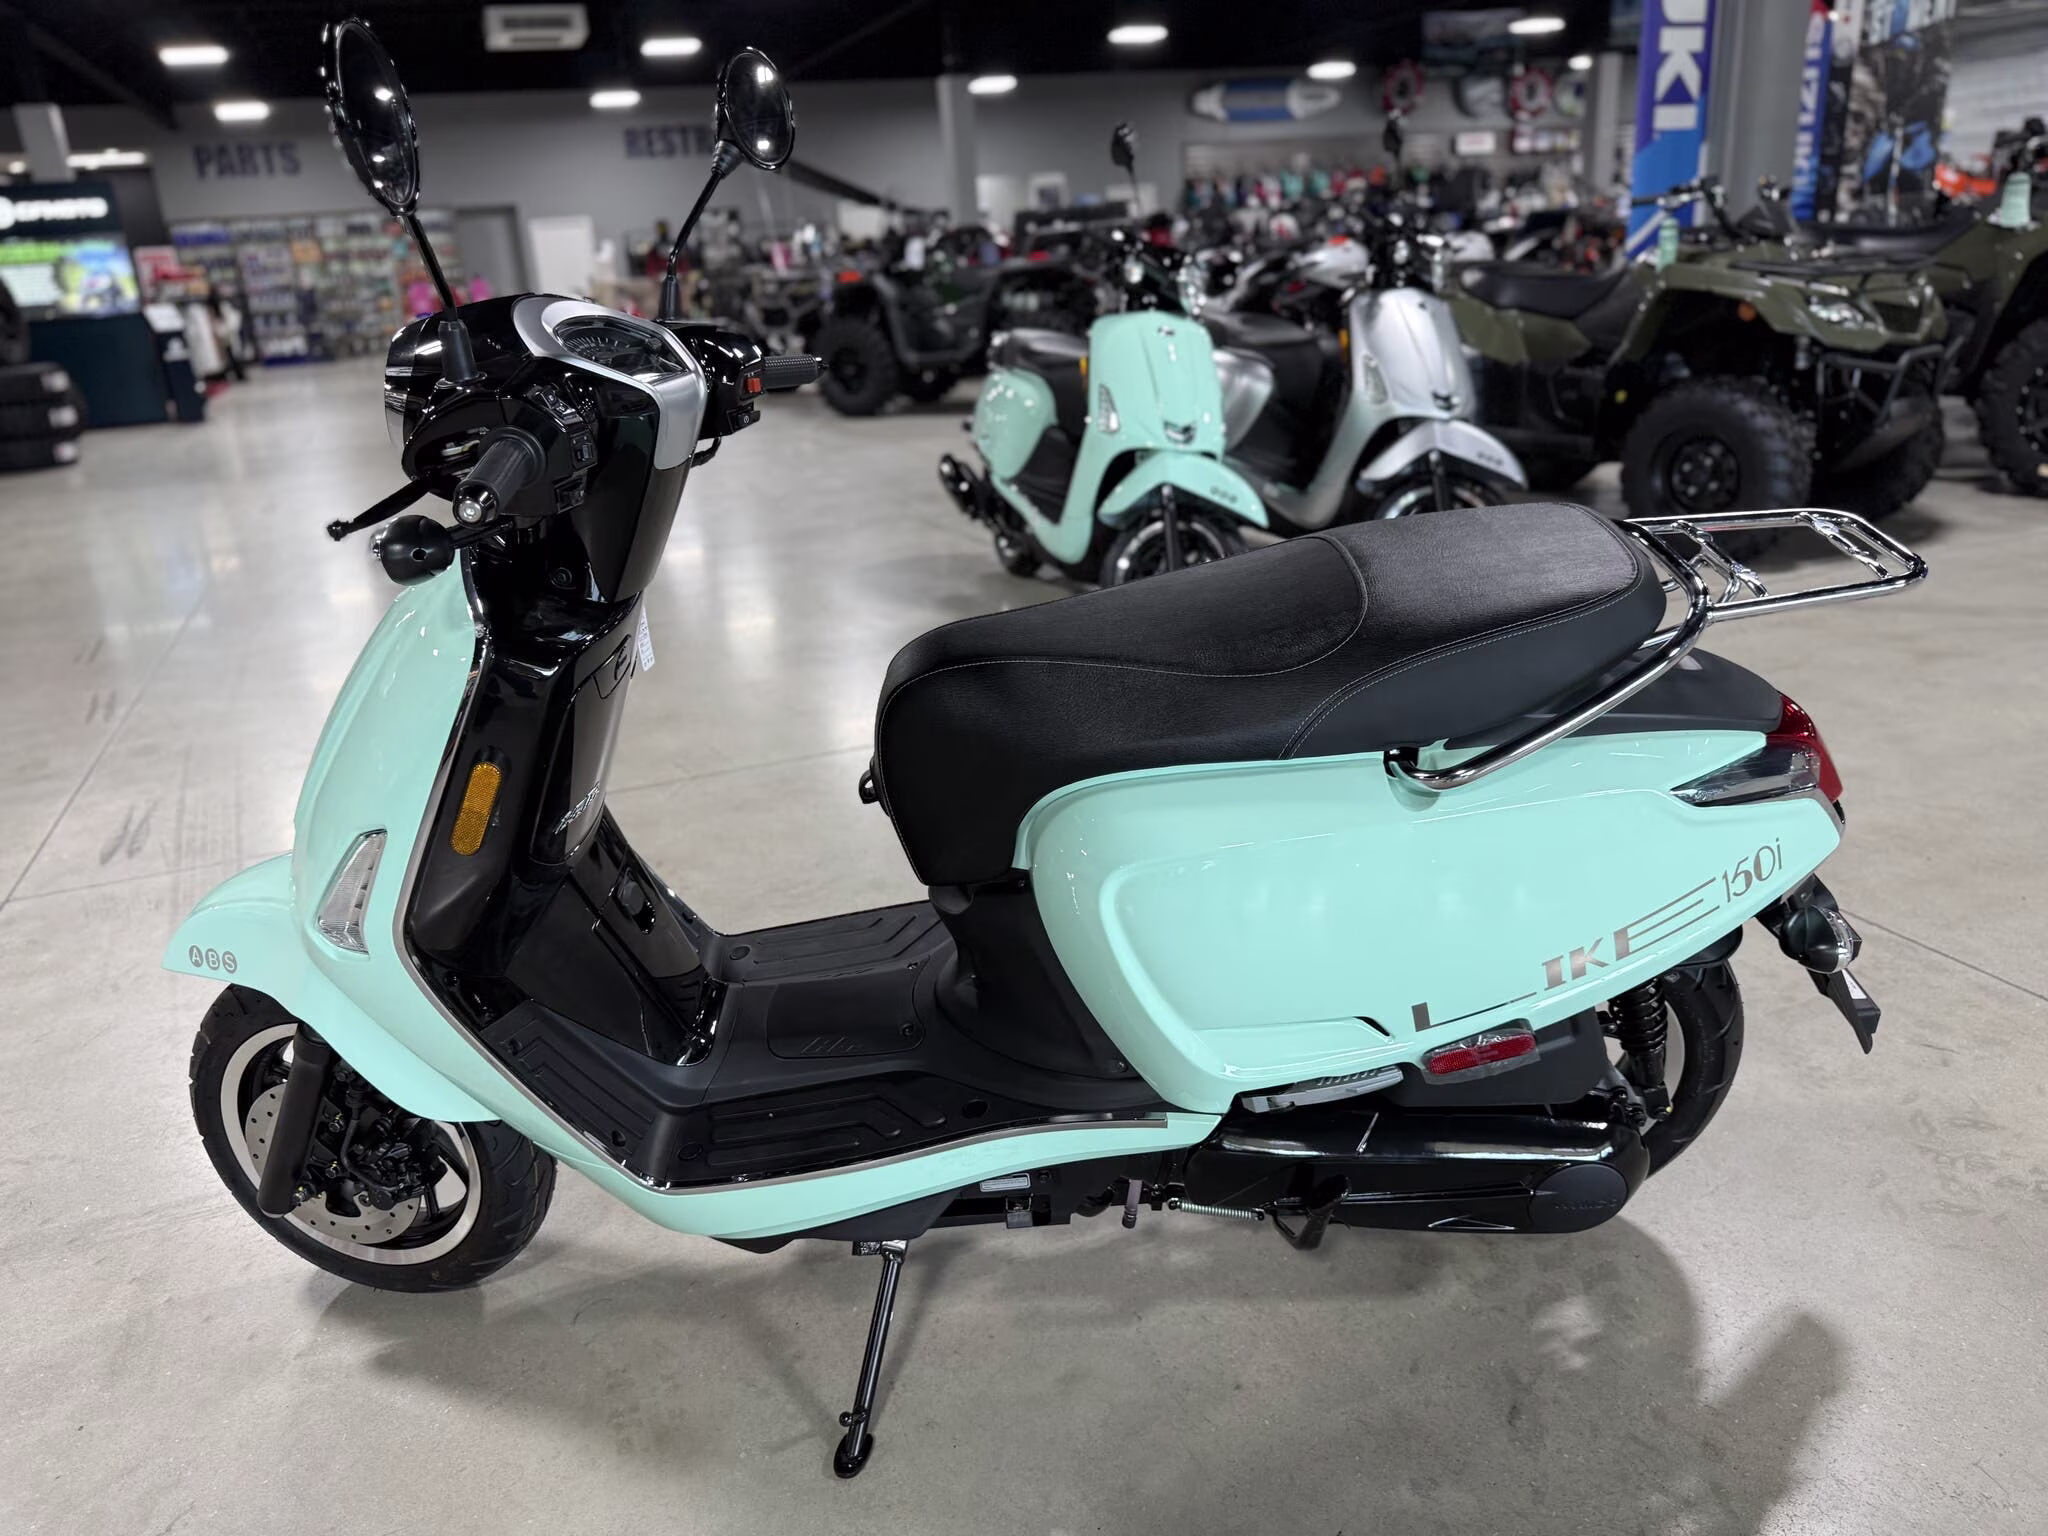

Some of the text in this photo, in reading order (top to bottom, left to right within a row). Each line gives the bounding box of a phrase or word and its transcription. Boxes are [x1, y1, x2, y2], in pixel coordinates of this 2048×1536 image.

[194, 143, 301, 179] PARTS
[1722, 837, 1782, 903] 150i
[189, 945, 237, 973] ABS
